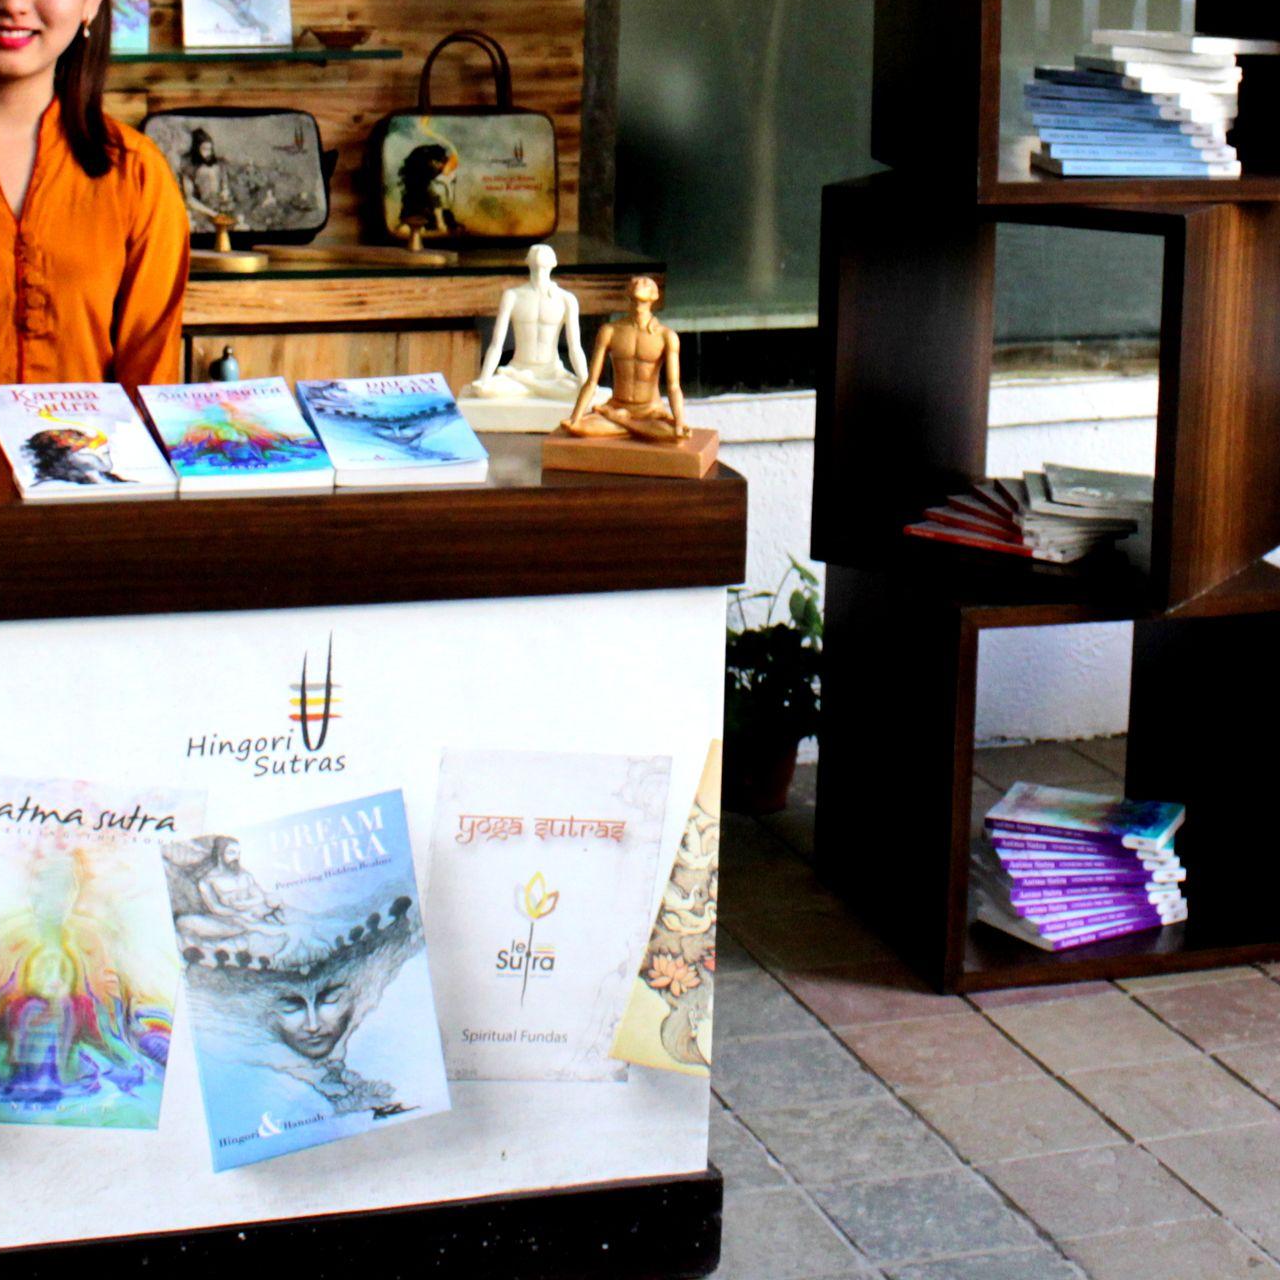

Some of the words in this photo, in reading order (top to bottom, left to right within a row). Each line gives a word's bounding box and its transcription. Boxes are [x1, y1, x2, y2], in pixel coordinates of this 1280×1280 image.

[11, 389, 99, 402] Karma
[23, 400, 100, 413] Sutra
[187, 728, 295, 762] Hingori
[254, 754, 347, 777] Sutras
[93, 804, 176, 832] sutra
[270, 806, 384, 853] DREAM
[455, 814, 524, 844] yoga
[534, 814, 626, 843] sutras
[271, 831, 387, 874] SUTRA
[462, 1028, 517, 1044] Spiritual
[520, 1030, 568, 1043] Fundas
[258, 1111, 282, 1139] &
